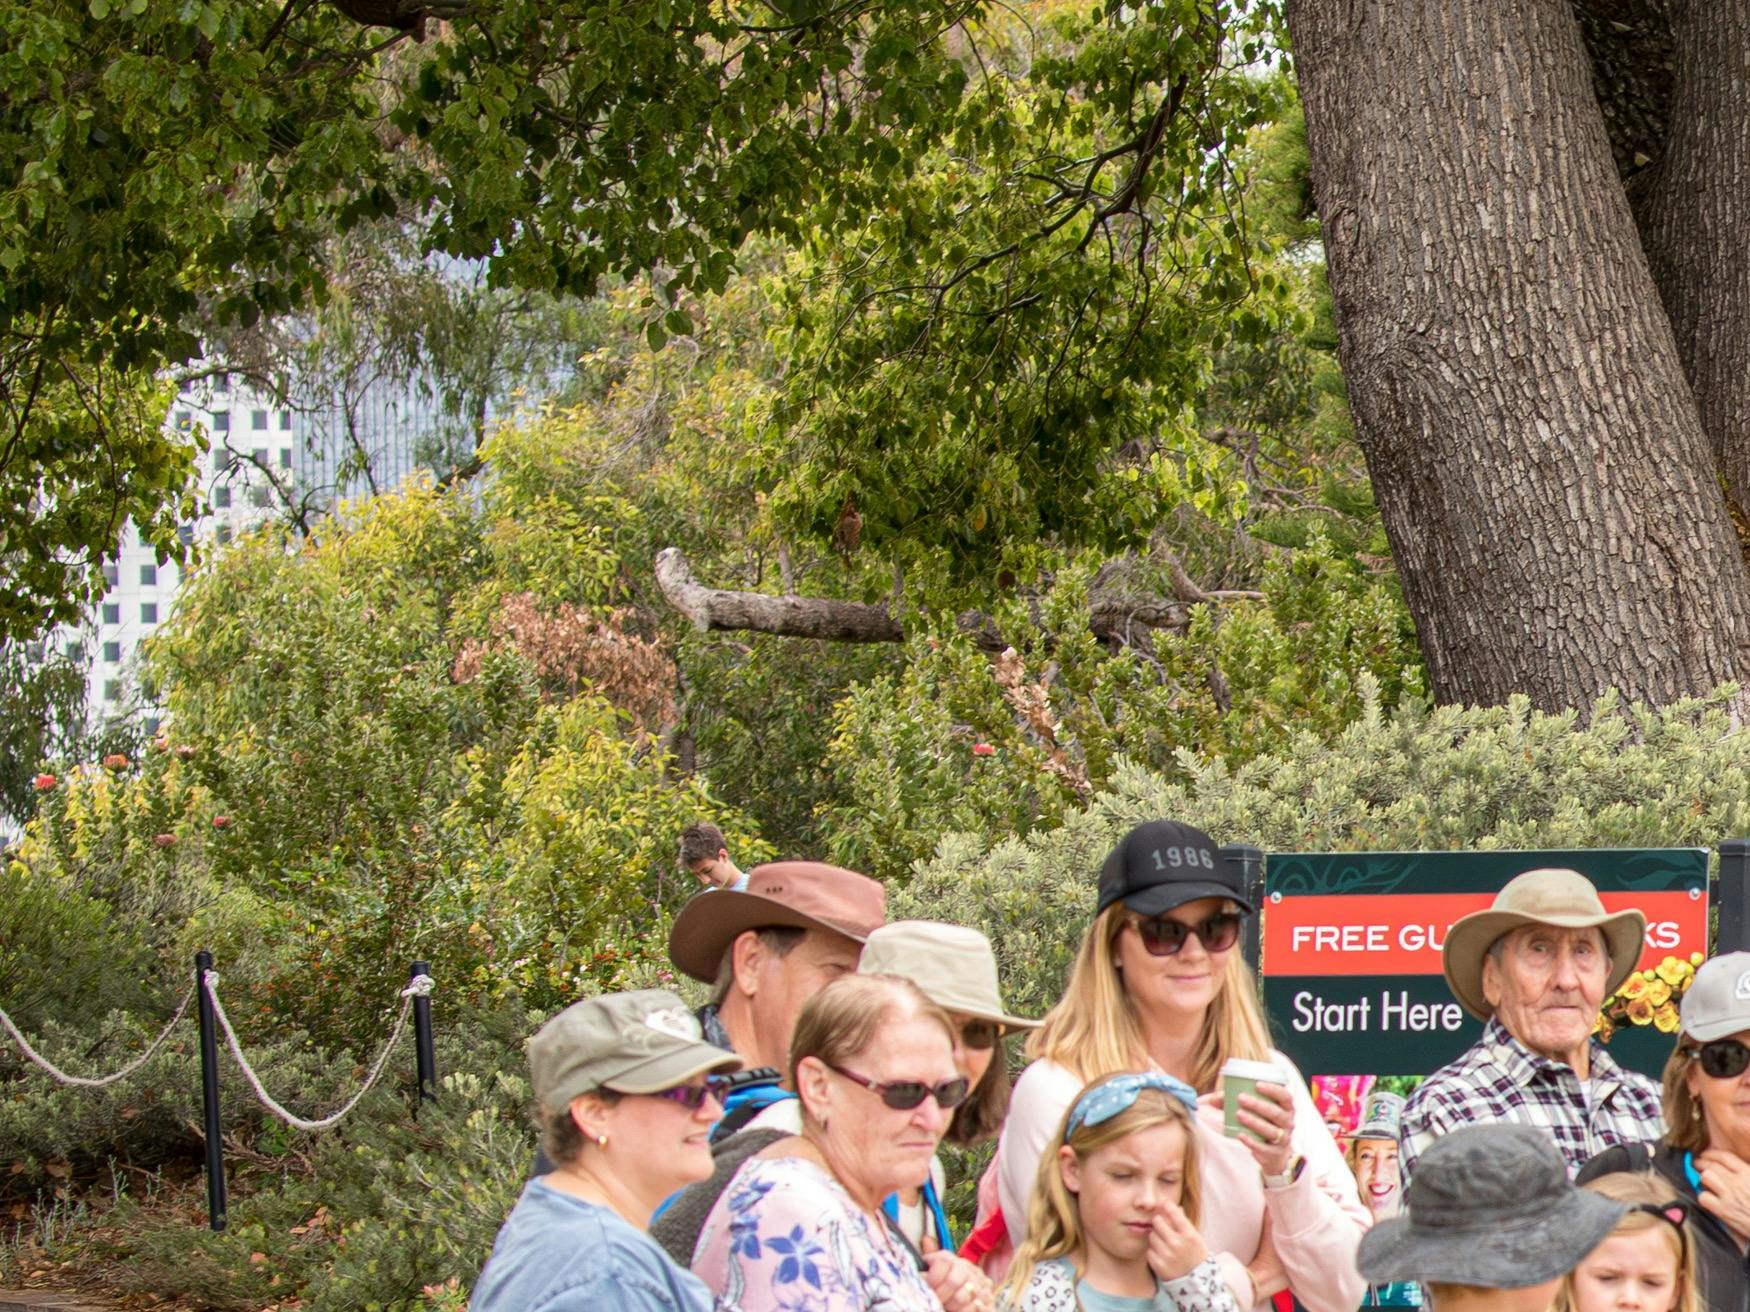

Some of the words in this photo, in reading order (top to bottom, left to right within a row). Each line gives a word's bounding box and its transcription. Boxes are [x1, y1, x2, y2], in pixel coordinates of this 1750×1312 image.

[1152, 846, 1214, 870] 1986
[1292, 925, 1389, 952] FREE
[1292, 991, 1370, 1032] Start
[1382, 990, 1463, 1032] Here
